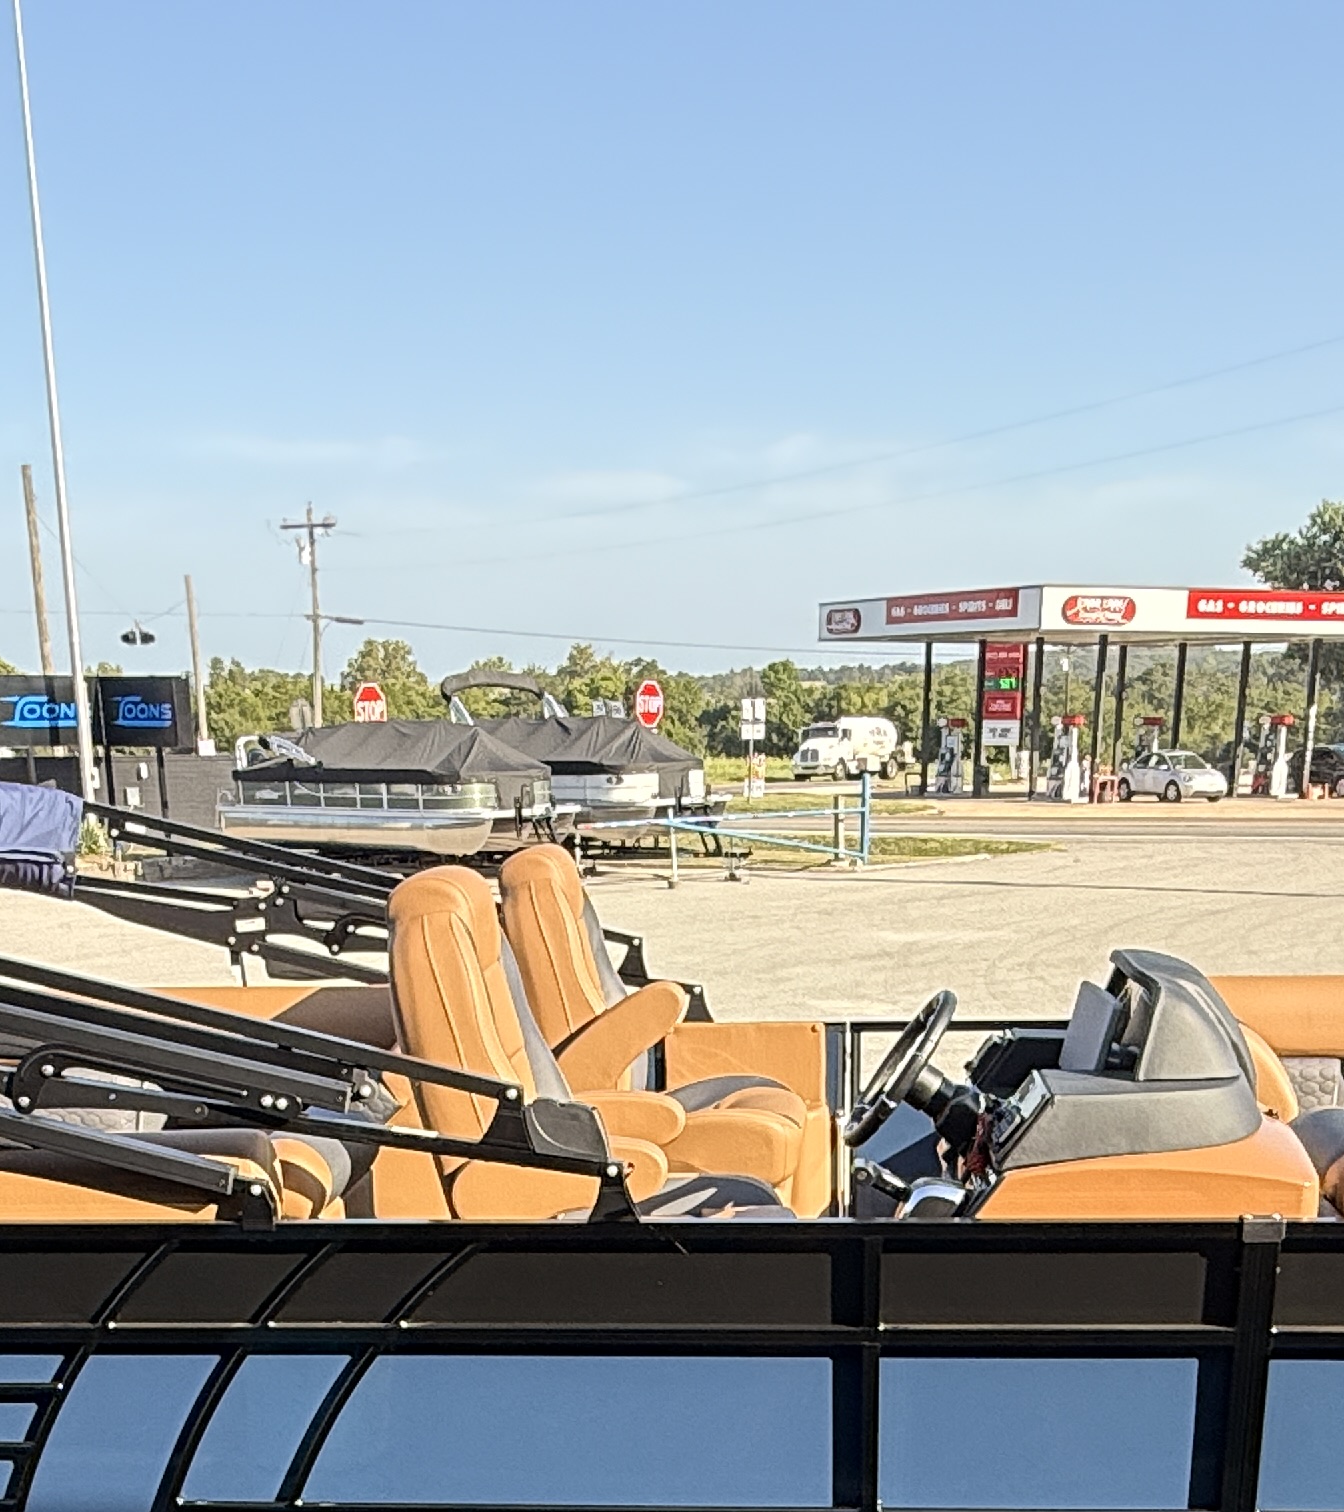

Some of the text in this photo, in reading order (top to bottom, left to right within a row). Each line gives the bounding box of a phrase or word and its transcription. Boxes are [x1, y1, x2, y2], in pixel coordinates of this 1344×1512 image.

[1197, 599, 1224, 613] GAS
[112, 695, 173, 728] TOONS
[356, 700, 386, 722] STOP
[638, 694, 662, 714] STOP
